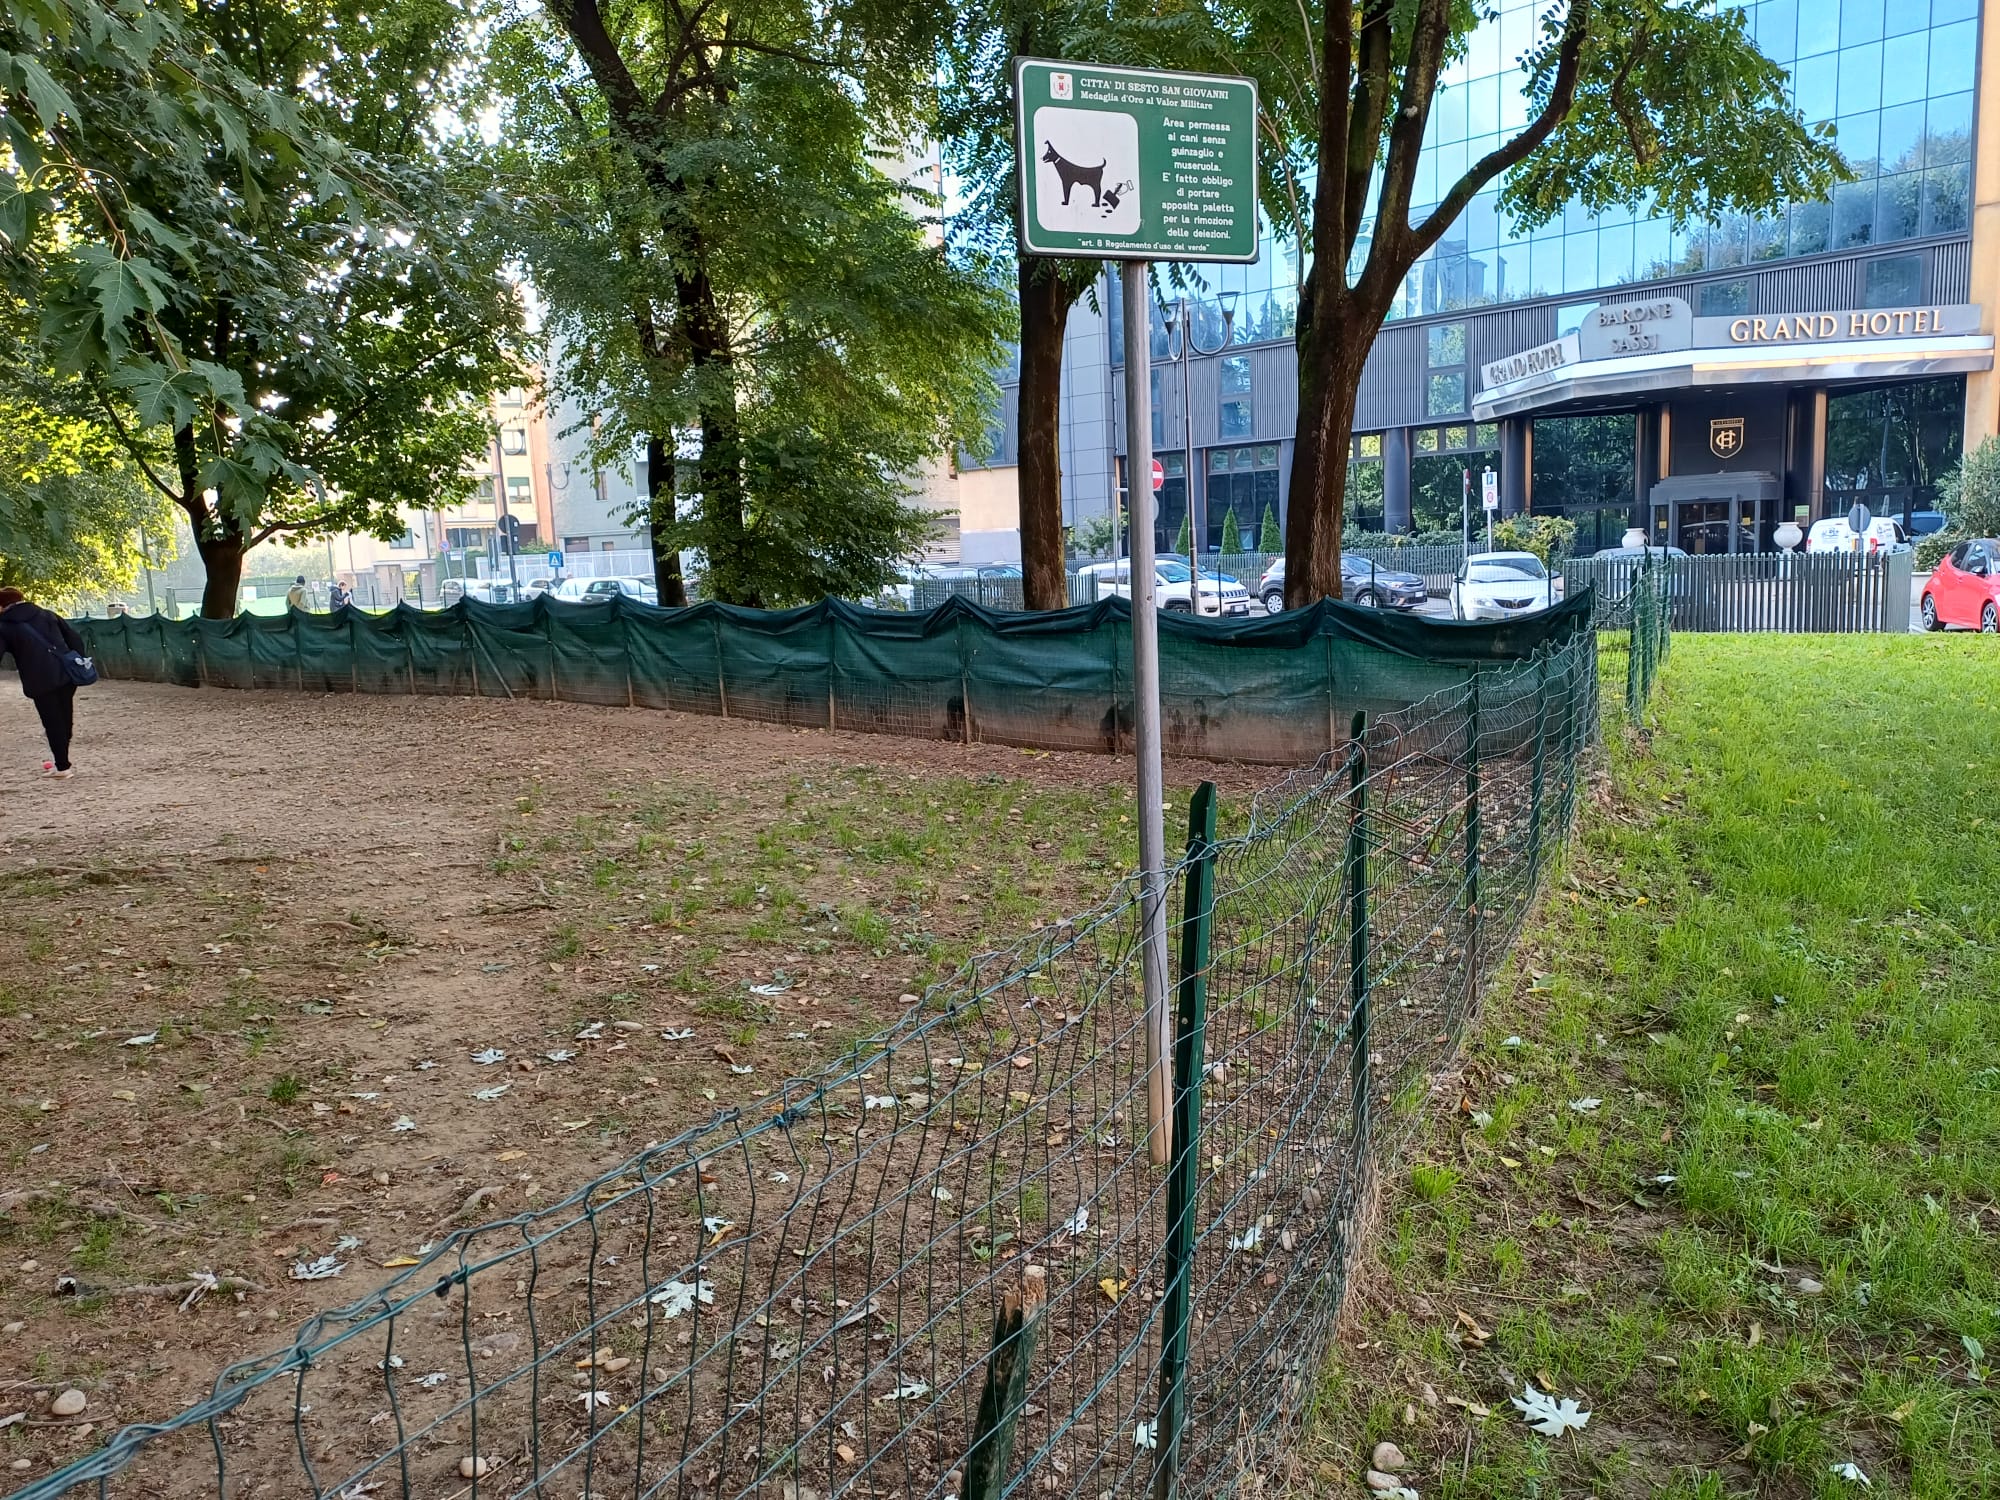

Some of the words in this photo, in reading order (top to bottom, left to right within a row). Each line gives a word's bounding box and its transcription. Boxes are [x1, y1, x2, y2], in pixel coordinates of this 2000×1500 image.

[1080, 78, 1112, 89] CITTA'
[1115, 81, 1125, 90] DI
[1128, 83, 1159, 93] SESTO
[1162, 86, 1180, 96] SAN
[1183, 88, 1229, 100] GIOVANNI
[1080, 90, 1118, 103] Medaglia
[1121, 94, 1143, 104] d'Oro
[1146, 97, 1154, 105] al
[1156, 97, 1178, 107] Valor
[1181, 98, 1213, 110] Militare
[1163, 116, 1185, 128] Area
[1189, 121, 1231, 132] permessa
[1168, 132, 1176, 141] ai
[1180, 134, 1198, 143] cani
[1202, 136, 1226, 145] senza
[1171, 147, 1214, 159] guinzaglio
[1174, 161, 1222, 172] museruola.
[1162, 172, 1171, 182] E'
[1175, 173, 1198, 184] fatto
[1202, 175, 1233, 188] obbligo
[1176, 187, 1184, 197] di
[1188, 189, 1220, 199] portare
[1162, 202, 1199, 211] apposita
[1203, 203, 1234, 213] paletta
[1163, 215, 1177, 224] per
[1181, 214, 1190, 224] la
[1194, 216, 1233, 226] rimozione
[1167, 228, 1189, 237] delle
[1193, 229, 1231, 239] deiezioni.
[1105, 239, 1151, 249] Regolamento
[1153, 241, 1171, 250] d'uso
[1174, 242, 1184, 250] del
[1599, 303, 1672, 327] BARONE
[1627, 323, 1641, 336] DI
[1730, 314, 1838, 342] GRAND
[1849, 309, 1944, 337] HOTEL
